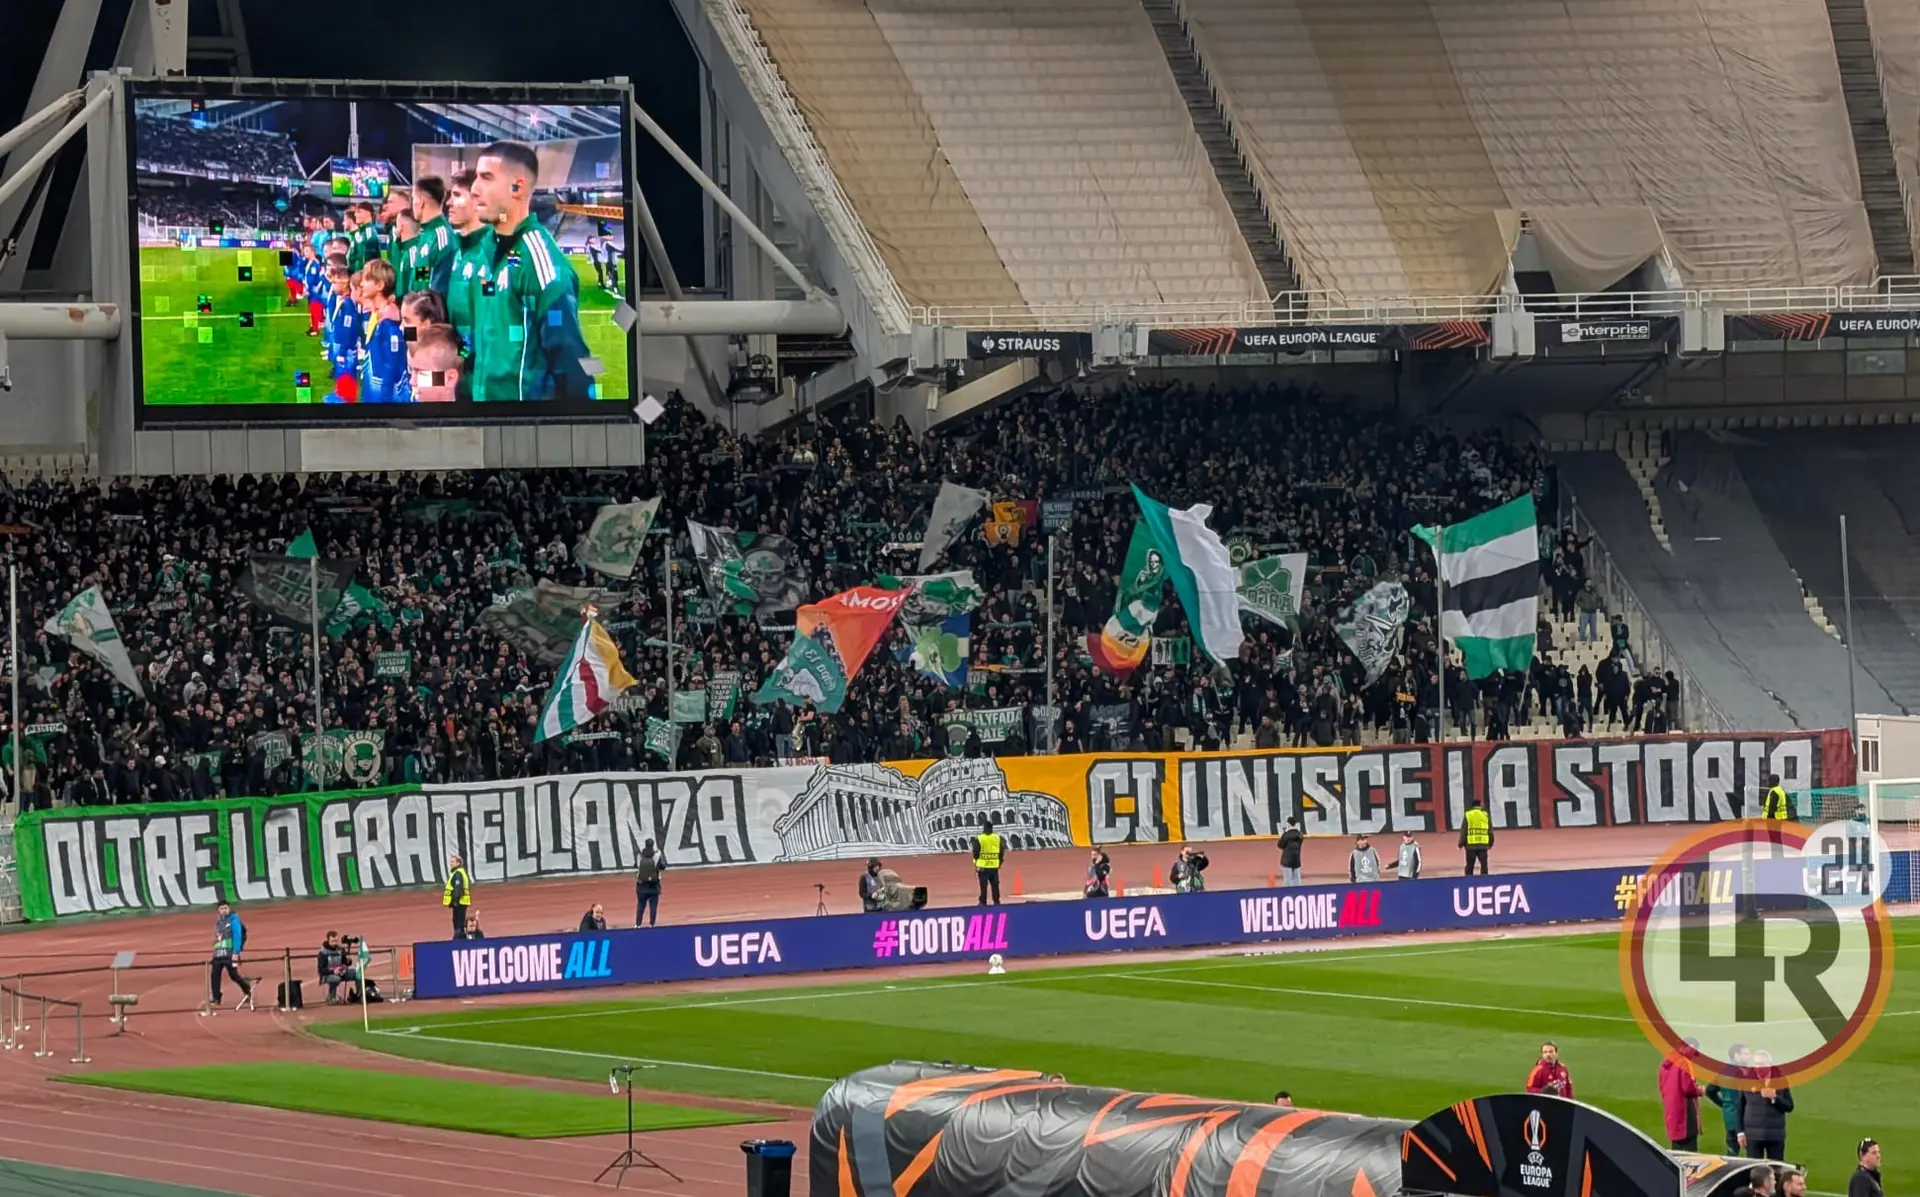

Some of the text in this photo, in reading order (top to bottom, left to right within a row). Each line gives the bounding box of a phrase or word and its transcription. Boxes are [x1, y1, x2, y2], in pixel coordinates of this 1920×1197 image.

[1244, 331, 1378, 347] UEFA EUROPA LEAGUE
[1567, 324, 1648, 338] enterprise
[1839, 319, 1873, 331] UEFA
[997, 337, 1061, 352] STRAUSS
[44, 739, 1813, 916] OLTRE LA FRATELLANZA CI UNISCE LA STORIA
[1453, 883, 1531, 918] UEFA
[1613, 868, 1734, 911] #FOOTBALL
[1084, 905, 1168, 941] UEFA
[1240, 889, 1381, 934] WELCOME ALL
[694, 930, 782, 968] UEFA
[872, 912, 1009, 958] #FOOTBALL
[451, 938, 612, 988] WELCOME ALL
[1520, 1163, 1553, 1179] EUROPA
[1523, 1175, 1551, 1188] LEAGUE
